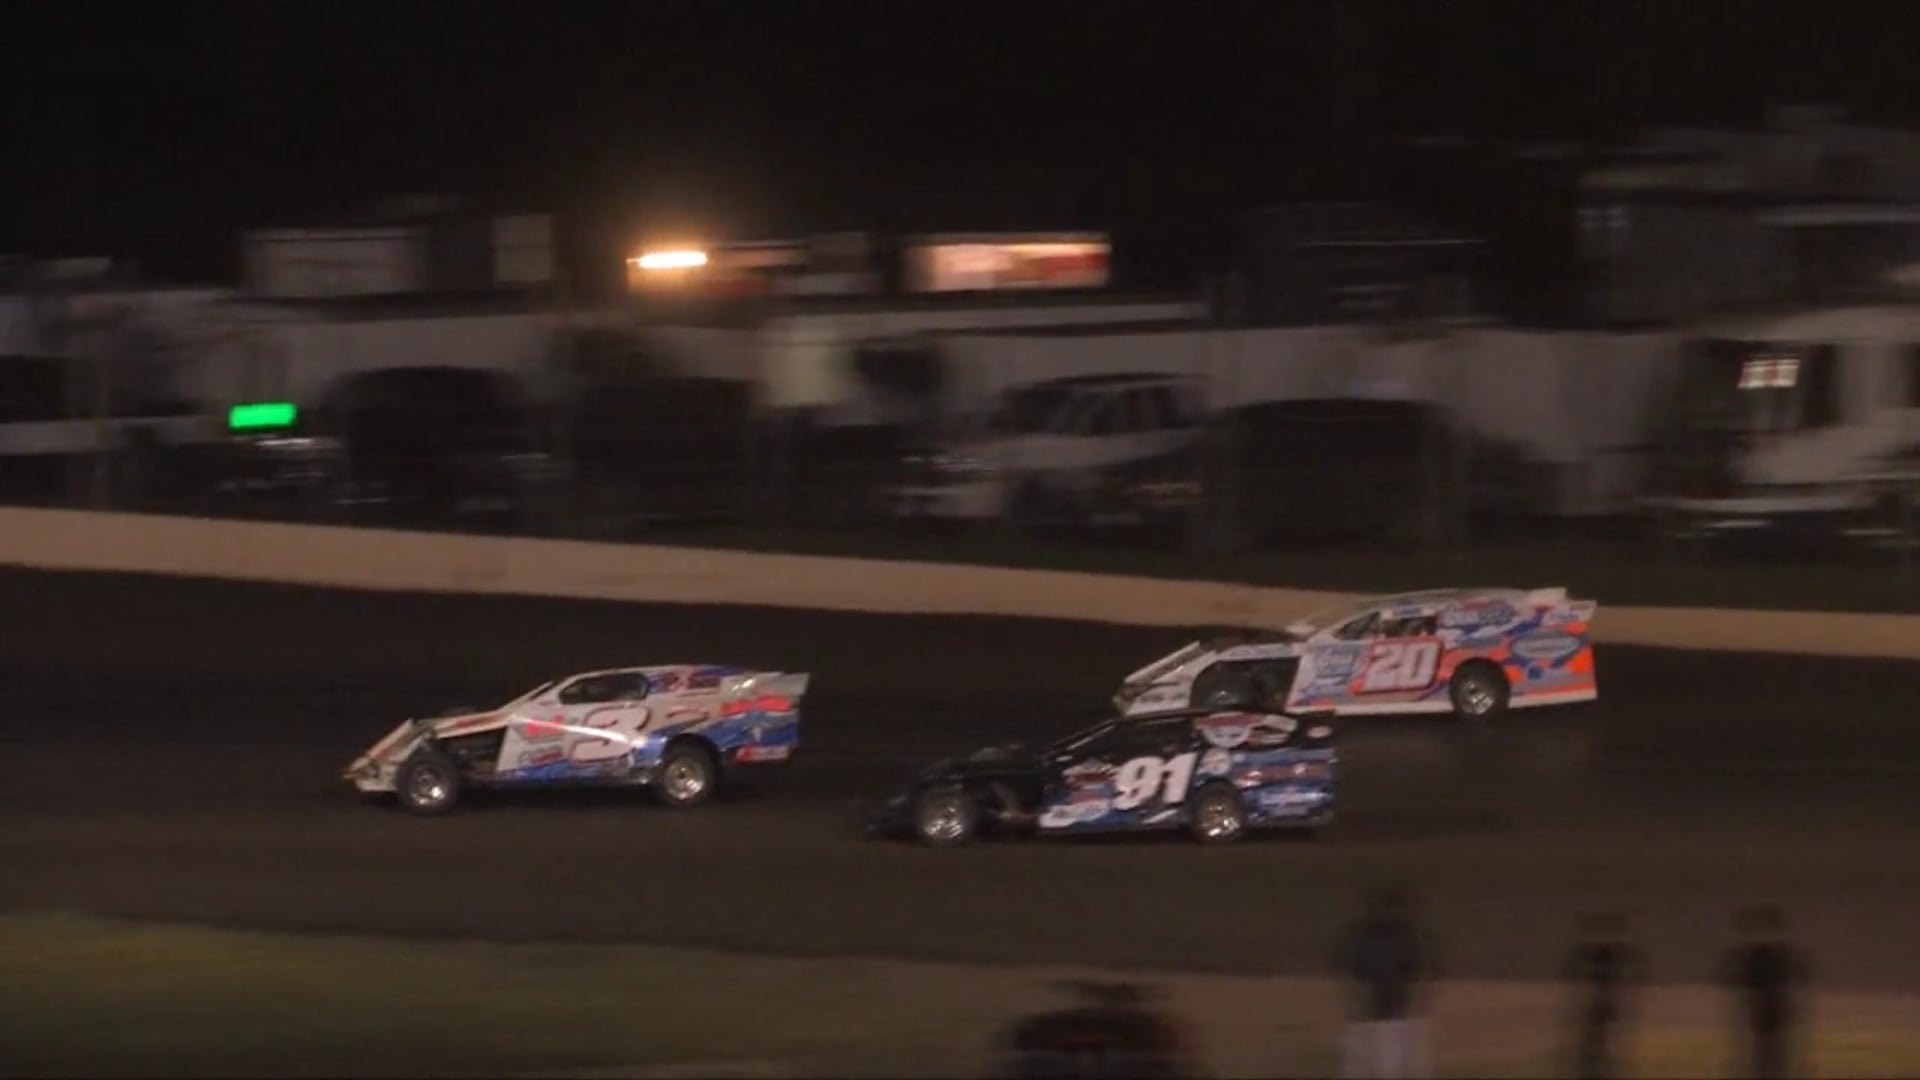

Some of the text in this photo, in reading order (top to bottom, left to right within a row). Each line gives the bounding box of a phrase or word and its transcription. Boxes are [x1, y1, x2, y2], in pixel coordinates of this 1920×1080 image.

[1359, 637, 1444, 694] 20
[569, 703, 649, 762] 3
[1112, 753, 1198, 811] 91
